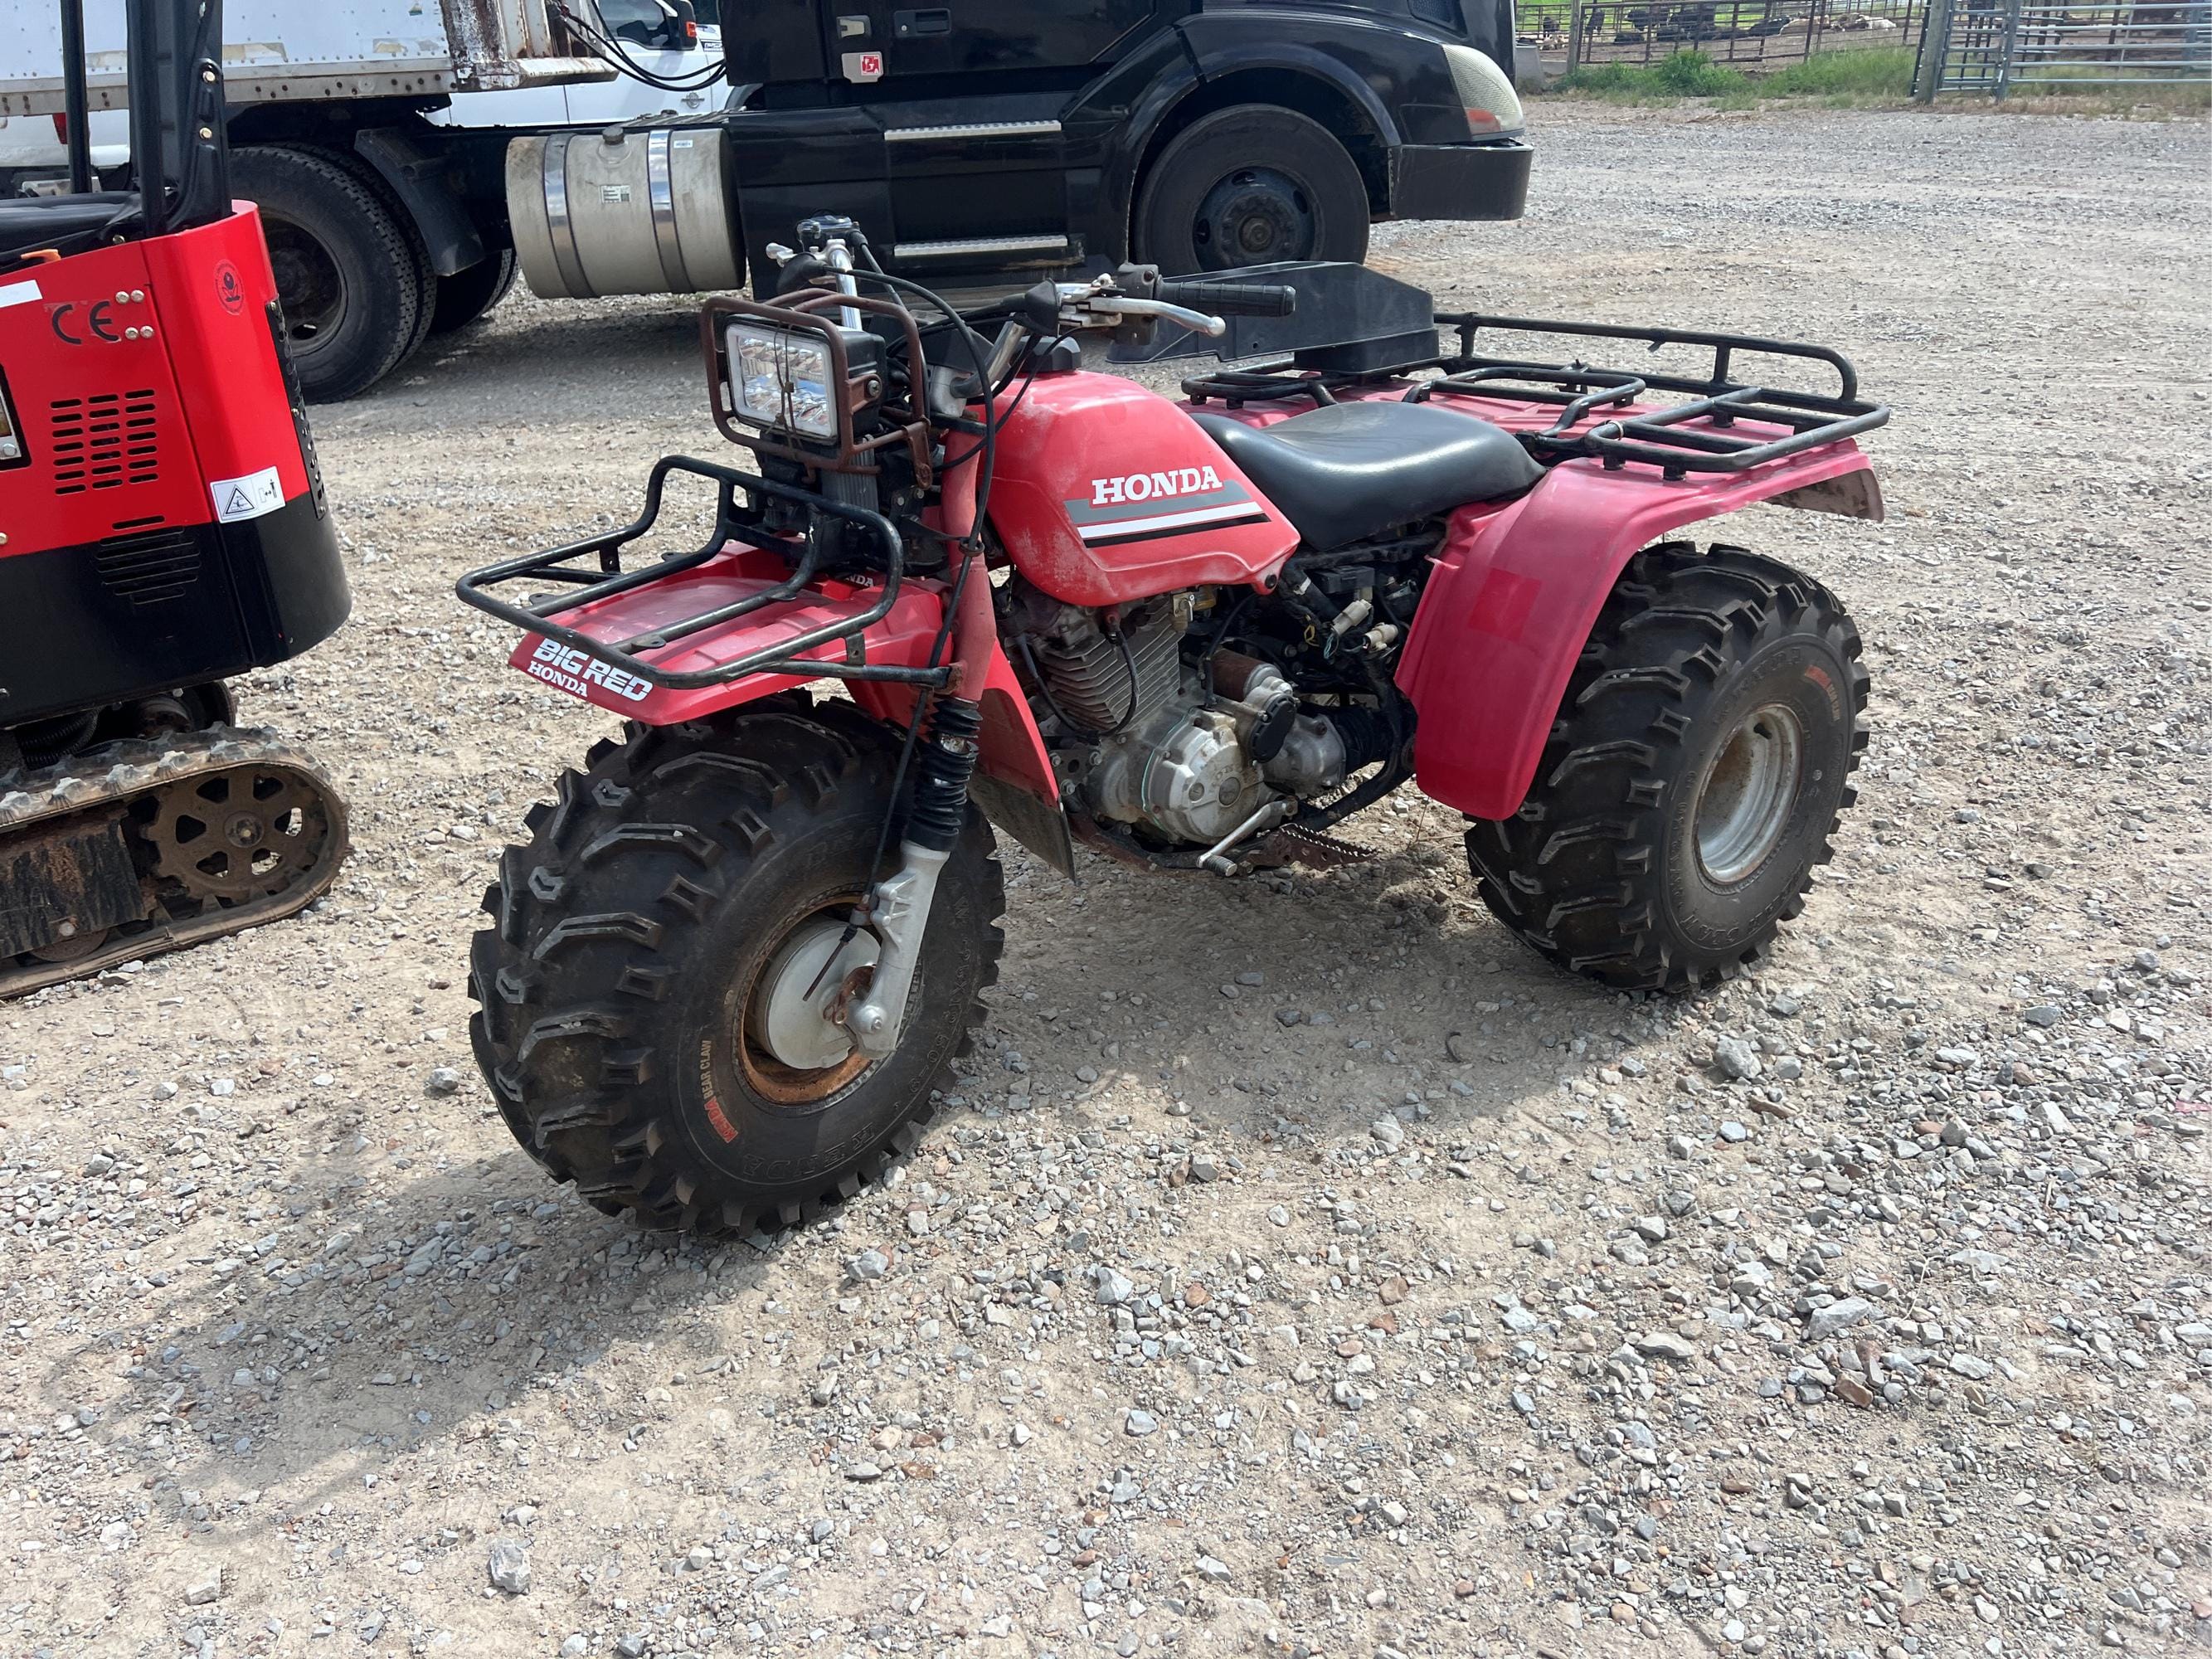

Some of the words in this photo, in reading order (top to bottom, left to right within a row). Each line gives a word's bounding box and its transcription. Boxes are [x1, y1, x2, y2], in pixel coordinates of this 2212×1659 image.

[51, 300, 119, 345] CE
[1091, 465, 1223, 504] HONDA
[527, 660, 588, 697] HONDA
[533, 638, 589, 675] BIG
[582, 659, 654, 702] RED
[700, 1040, 712, 1070] CLAW
[700, 1071, 713, 1100] BEAR
